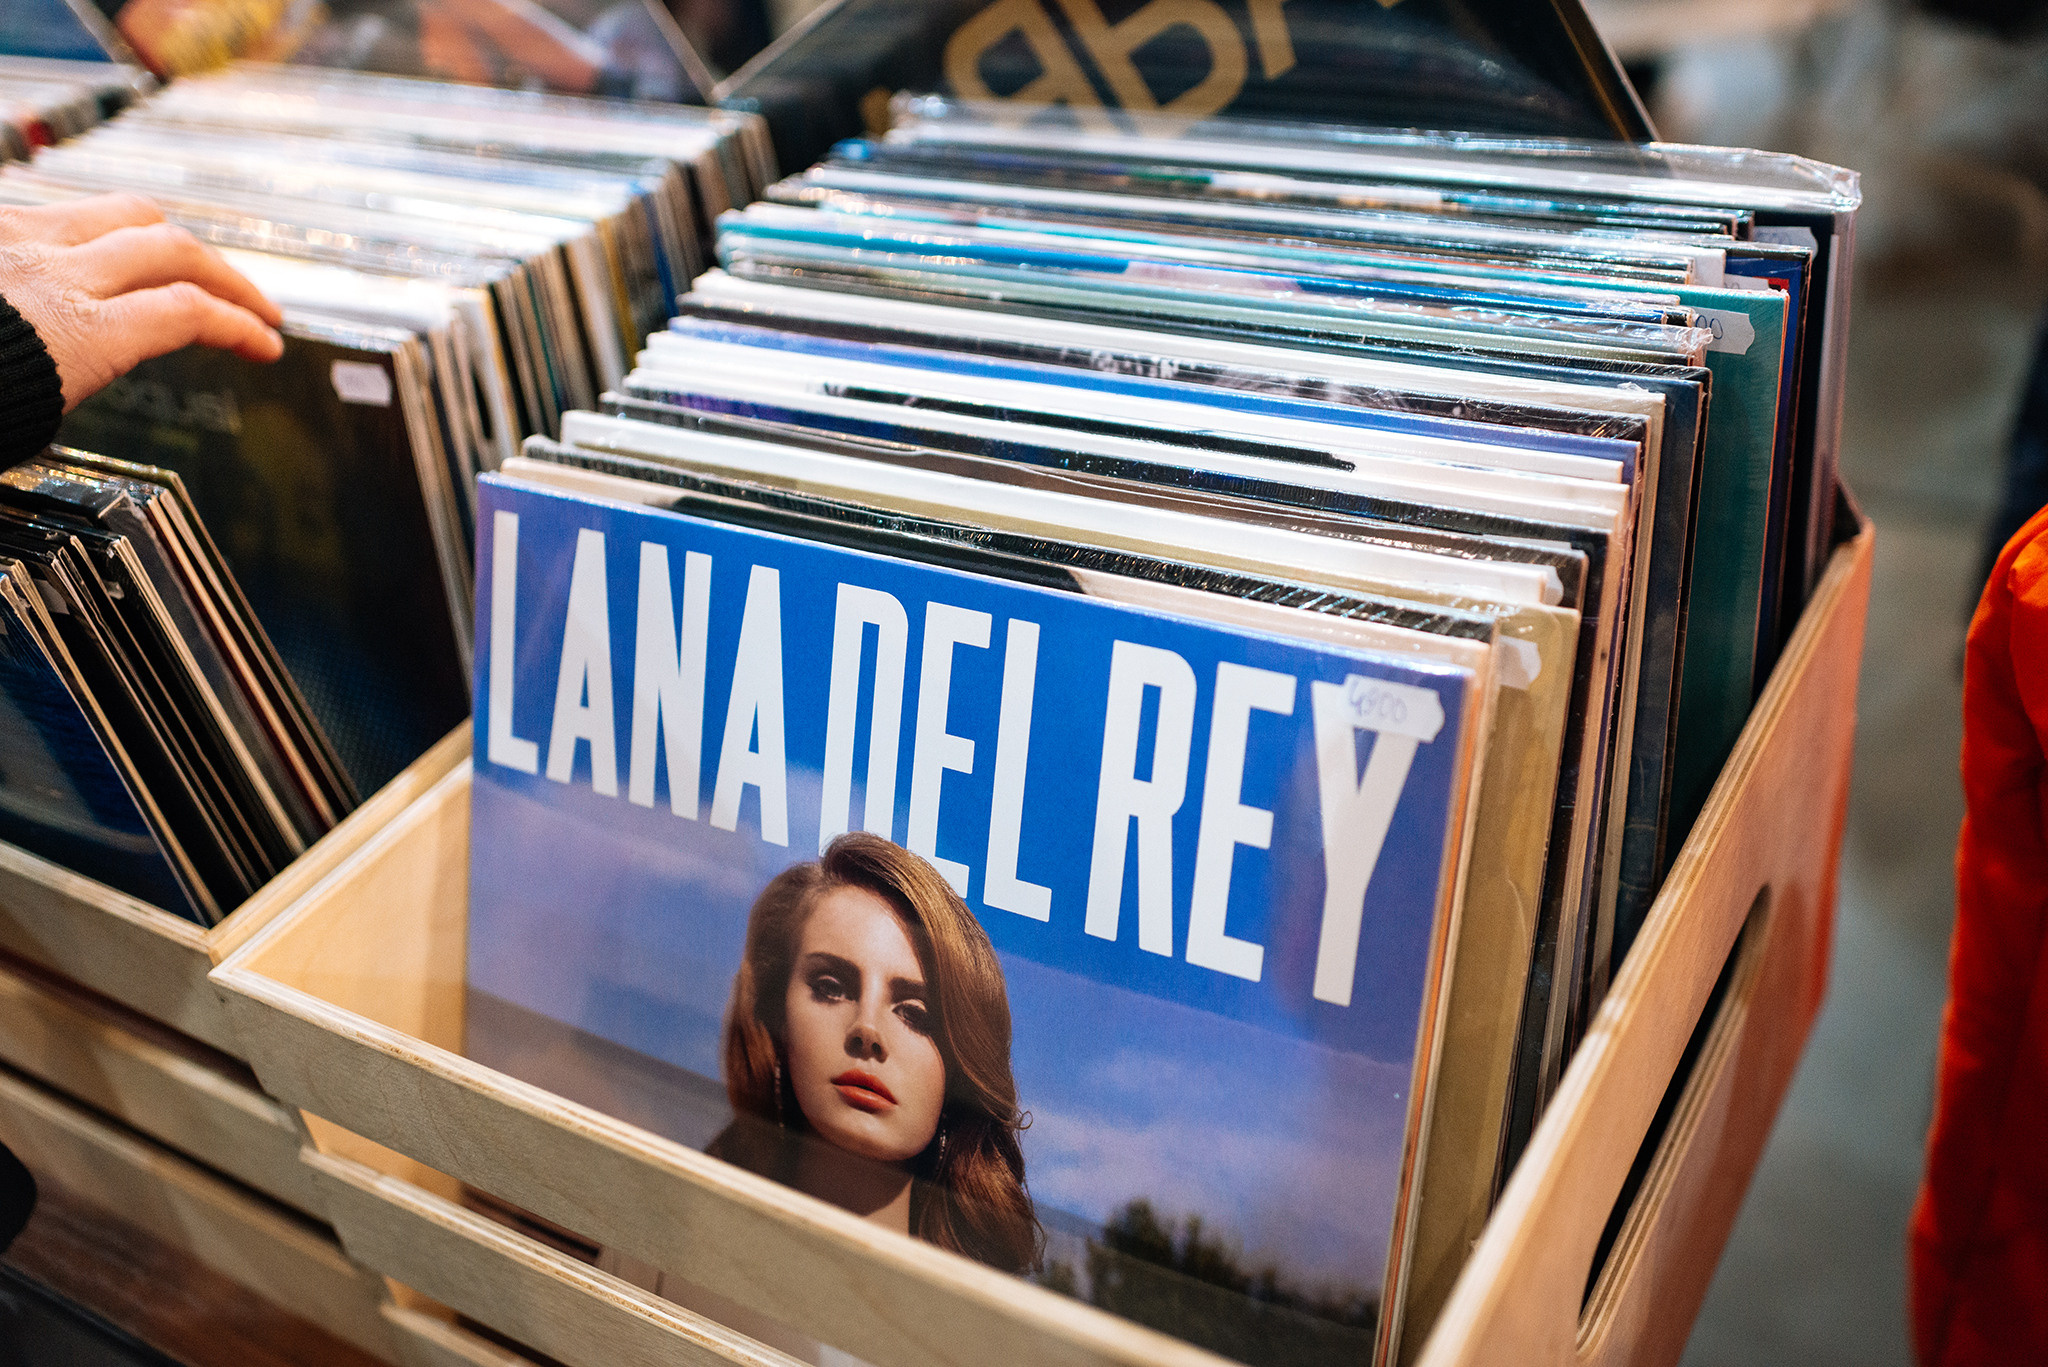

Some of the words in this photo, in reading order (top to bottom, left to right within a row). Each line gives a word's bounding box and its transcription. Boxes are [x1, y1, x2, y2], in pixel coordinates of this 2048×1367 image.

[489, 510, 788, 847] LANA
[818, 583, 1052, 922] DEL
[1085, 640, 1421, 1006] REY
